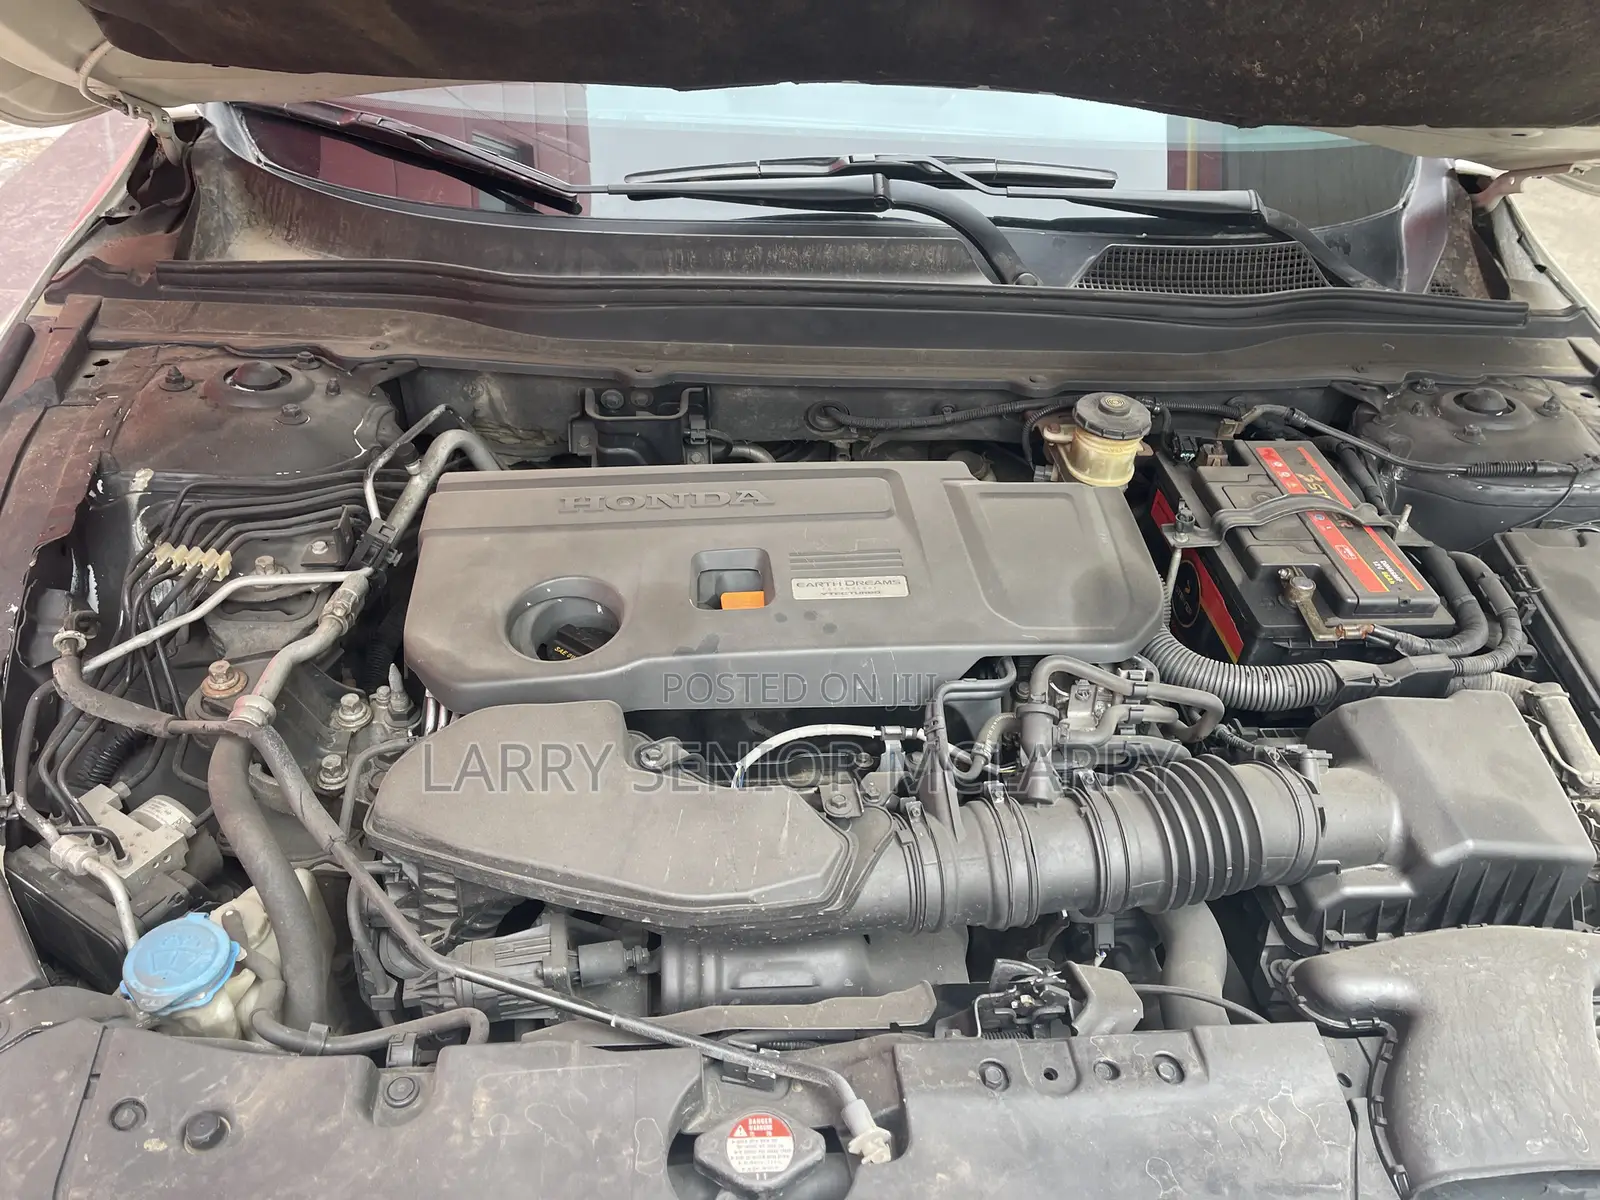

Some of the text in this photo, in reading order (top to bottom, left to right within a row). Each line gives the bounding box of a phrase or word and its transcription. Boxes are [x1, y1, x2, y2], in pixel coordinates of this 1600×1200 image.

[558, 490, 775, 514] HONDA
[845, 579, 901, 587] DREAMS
[554, 646, 569, 656] SAE
